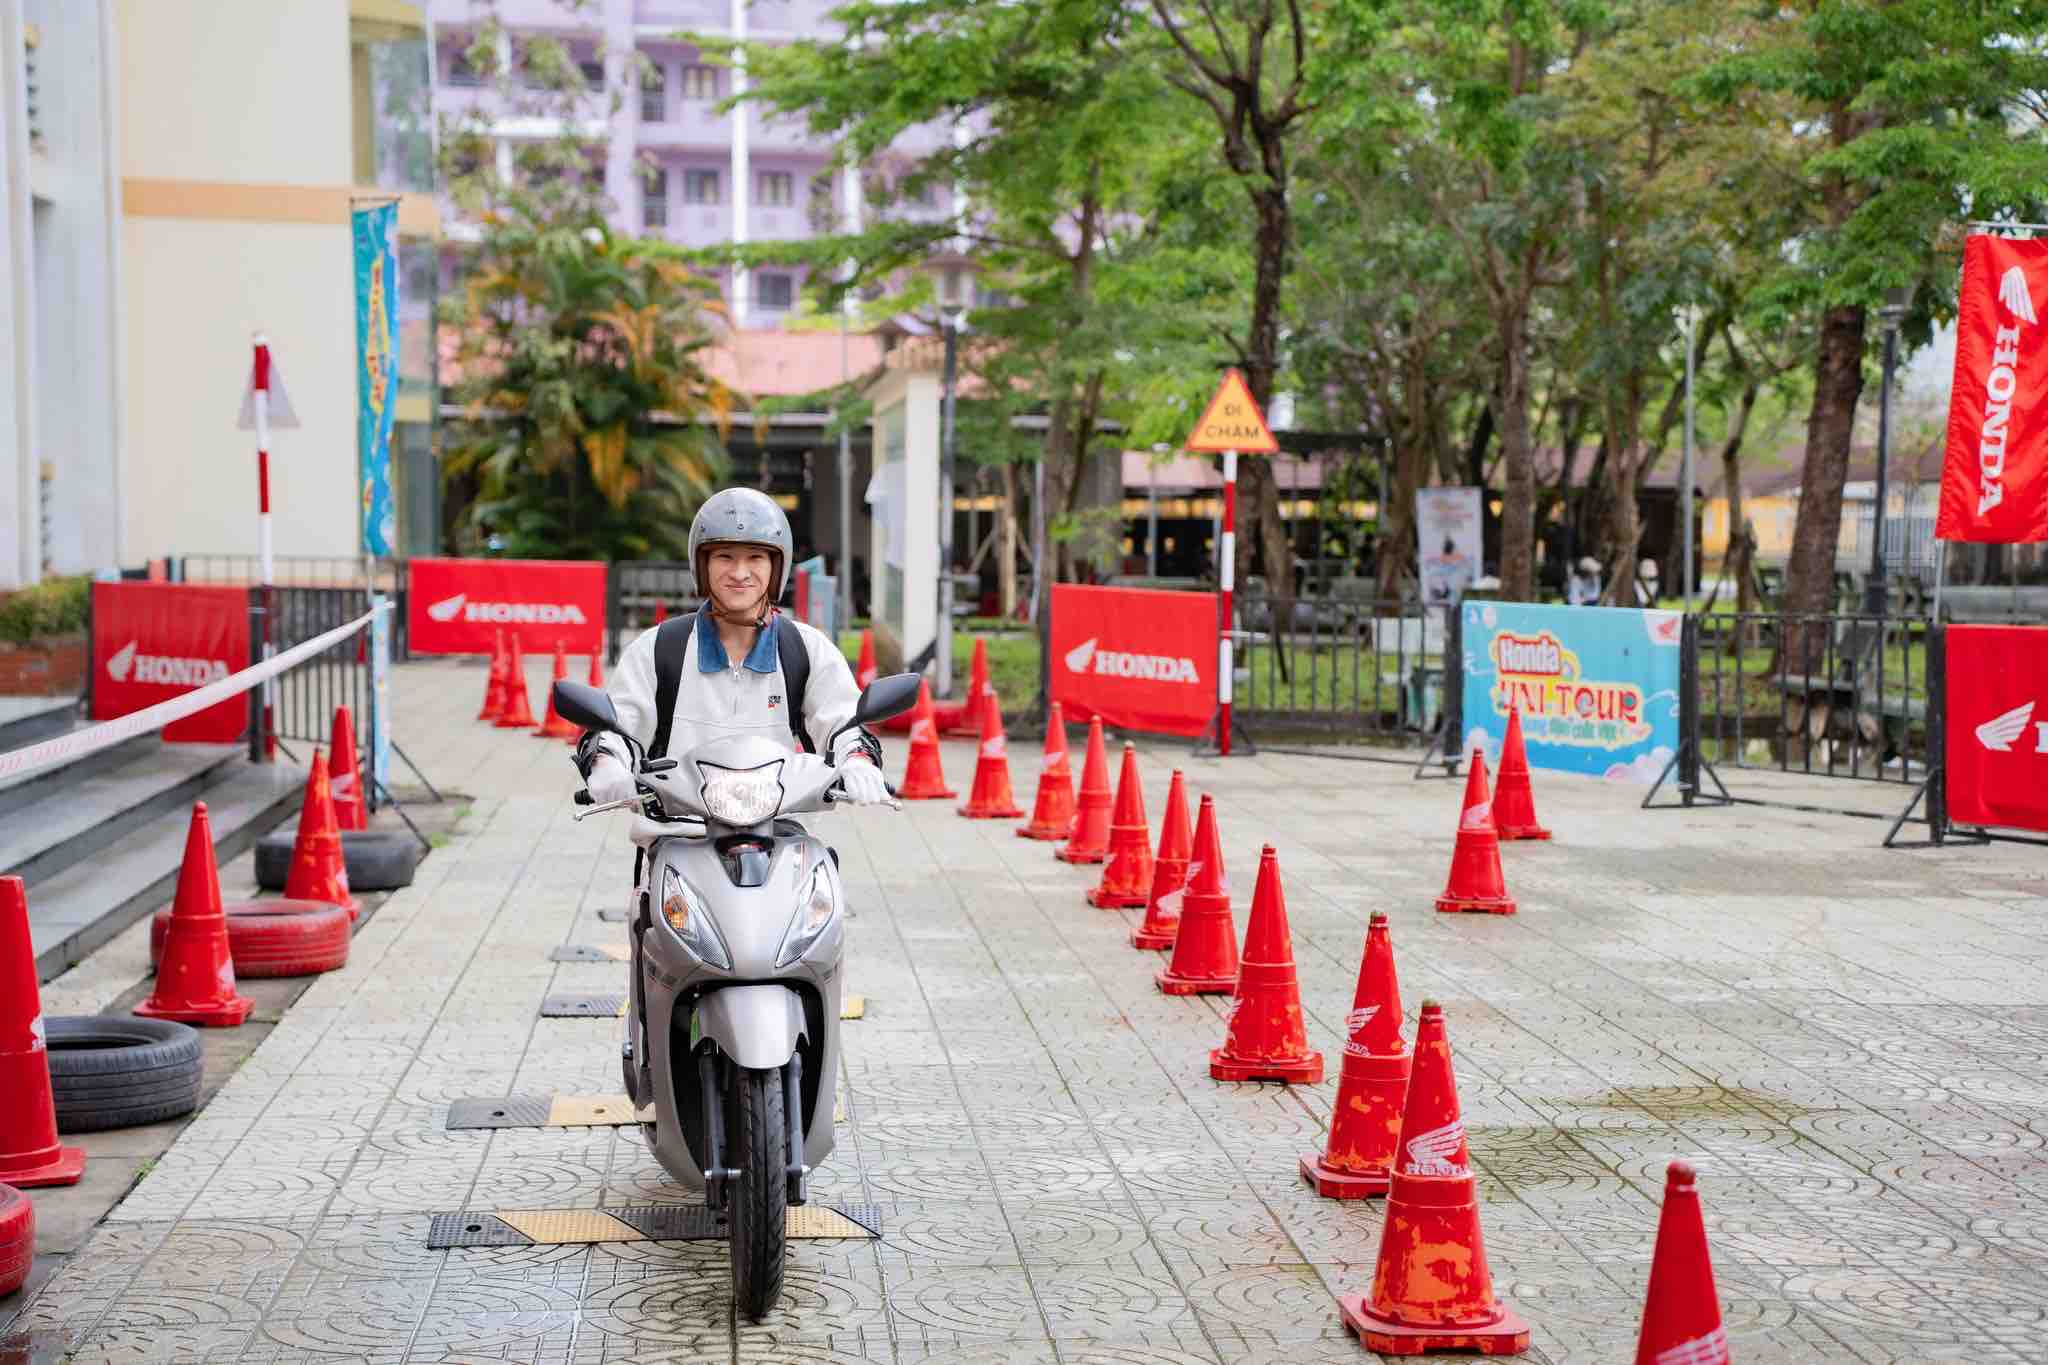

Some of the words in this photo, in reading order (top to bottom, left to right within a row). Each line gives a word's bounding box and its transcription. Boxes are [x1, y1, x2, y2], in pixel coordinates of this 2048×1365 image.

[1977, 323, 2020, 516] HONDA
[464, 602, 587, 624] HONDA
[134, 655, 231, 687] HONDA
[1095, 650, 1200, 684] HONDA
[1500, 636, 1560, 674] Honda
[1555, 684, 1637, 723] TOUR
